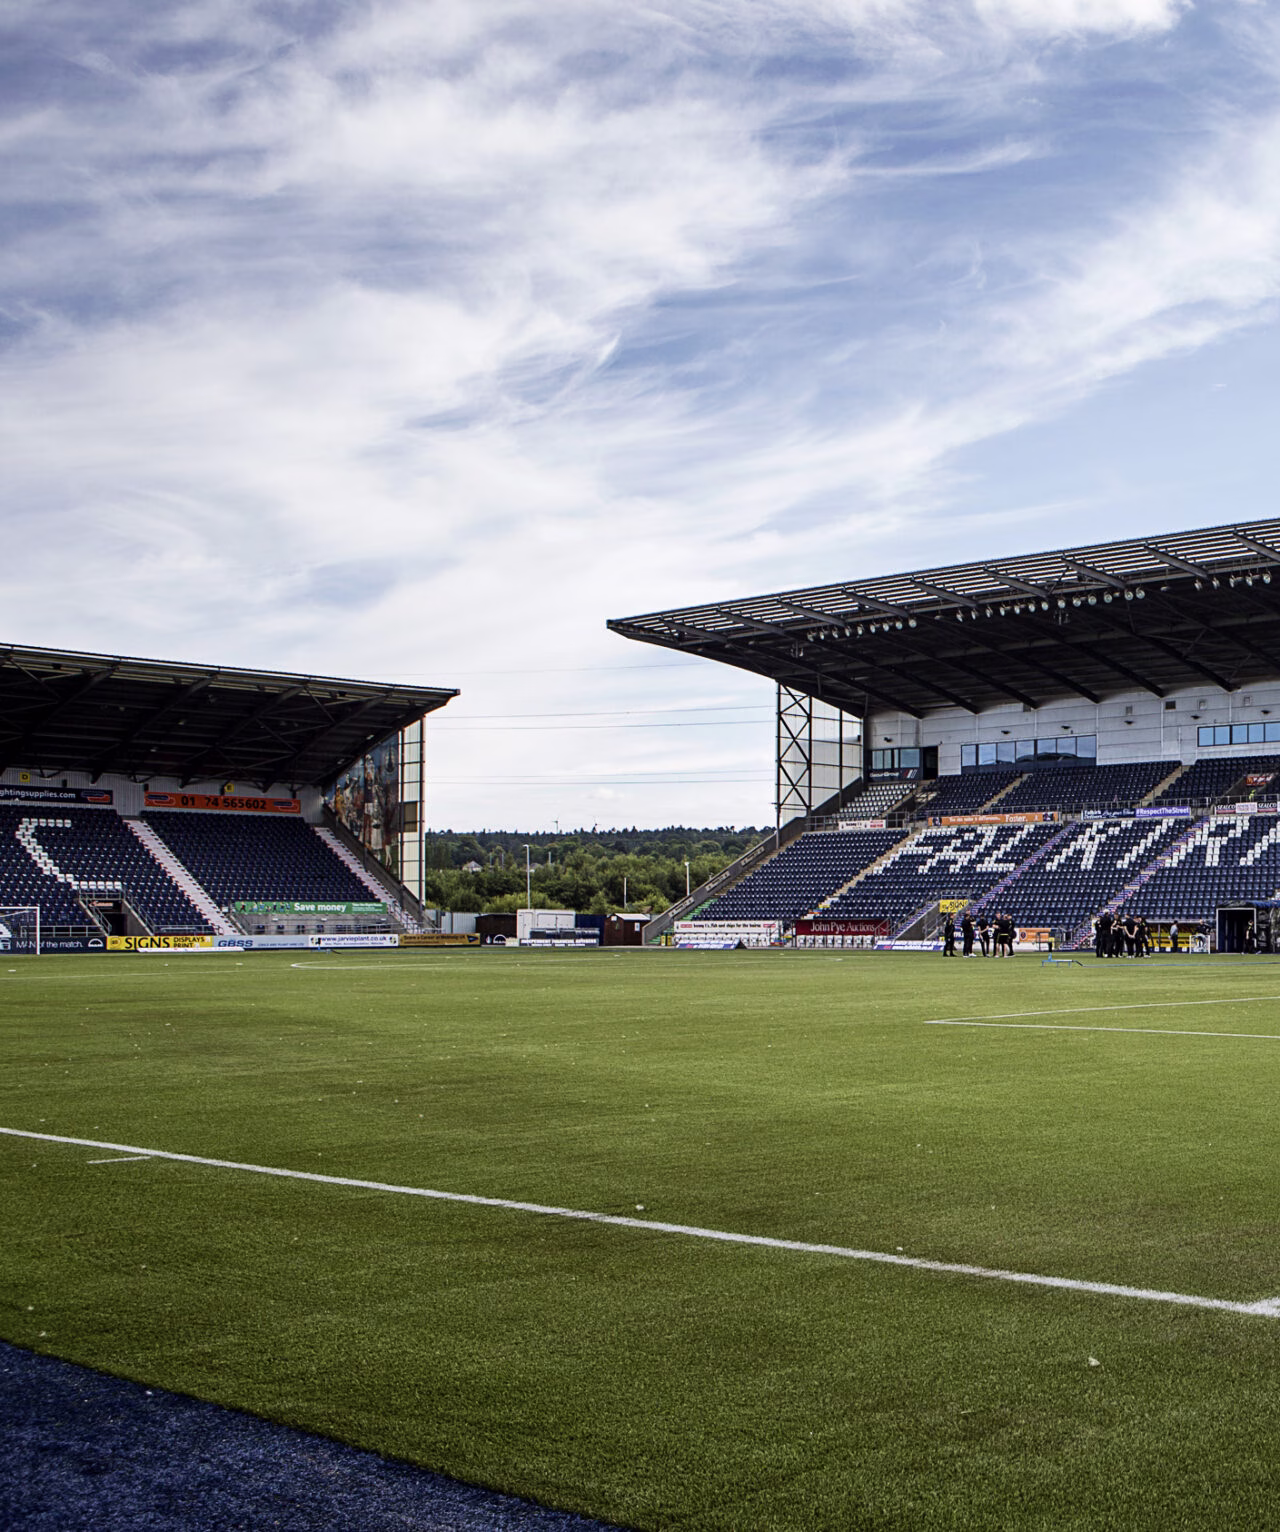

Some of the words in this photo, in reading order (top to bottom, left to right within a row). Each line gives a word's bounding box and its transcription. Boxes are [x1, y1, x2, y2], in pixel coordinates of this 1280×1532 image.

[222, 798, 267, 810] 565602
[1136, 806, 1189, 817] #RespectTheStreet
[294, 902, 315, 911] Save
[317, 903, 347, 913] money
[810, 921, 830, 933] John
[830, 921, 845, 935] Pye
[845, 921, 875, 933] Auctions
[46, 940, 58, 948] the
[124, 936, 170, 949] SIGNS
[217, 939, 254, 948] GBSS
[321, 935, 387, 943] www.jarvieplant.co.uk
